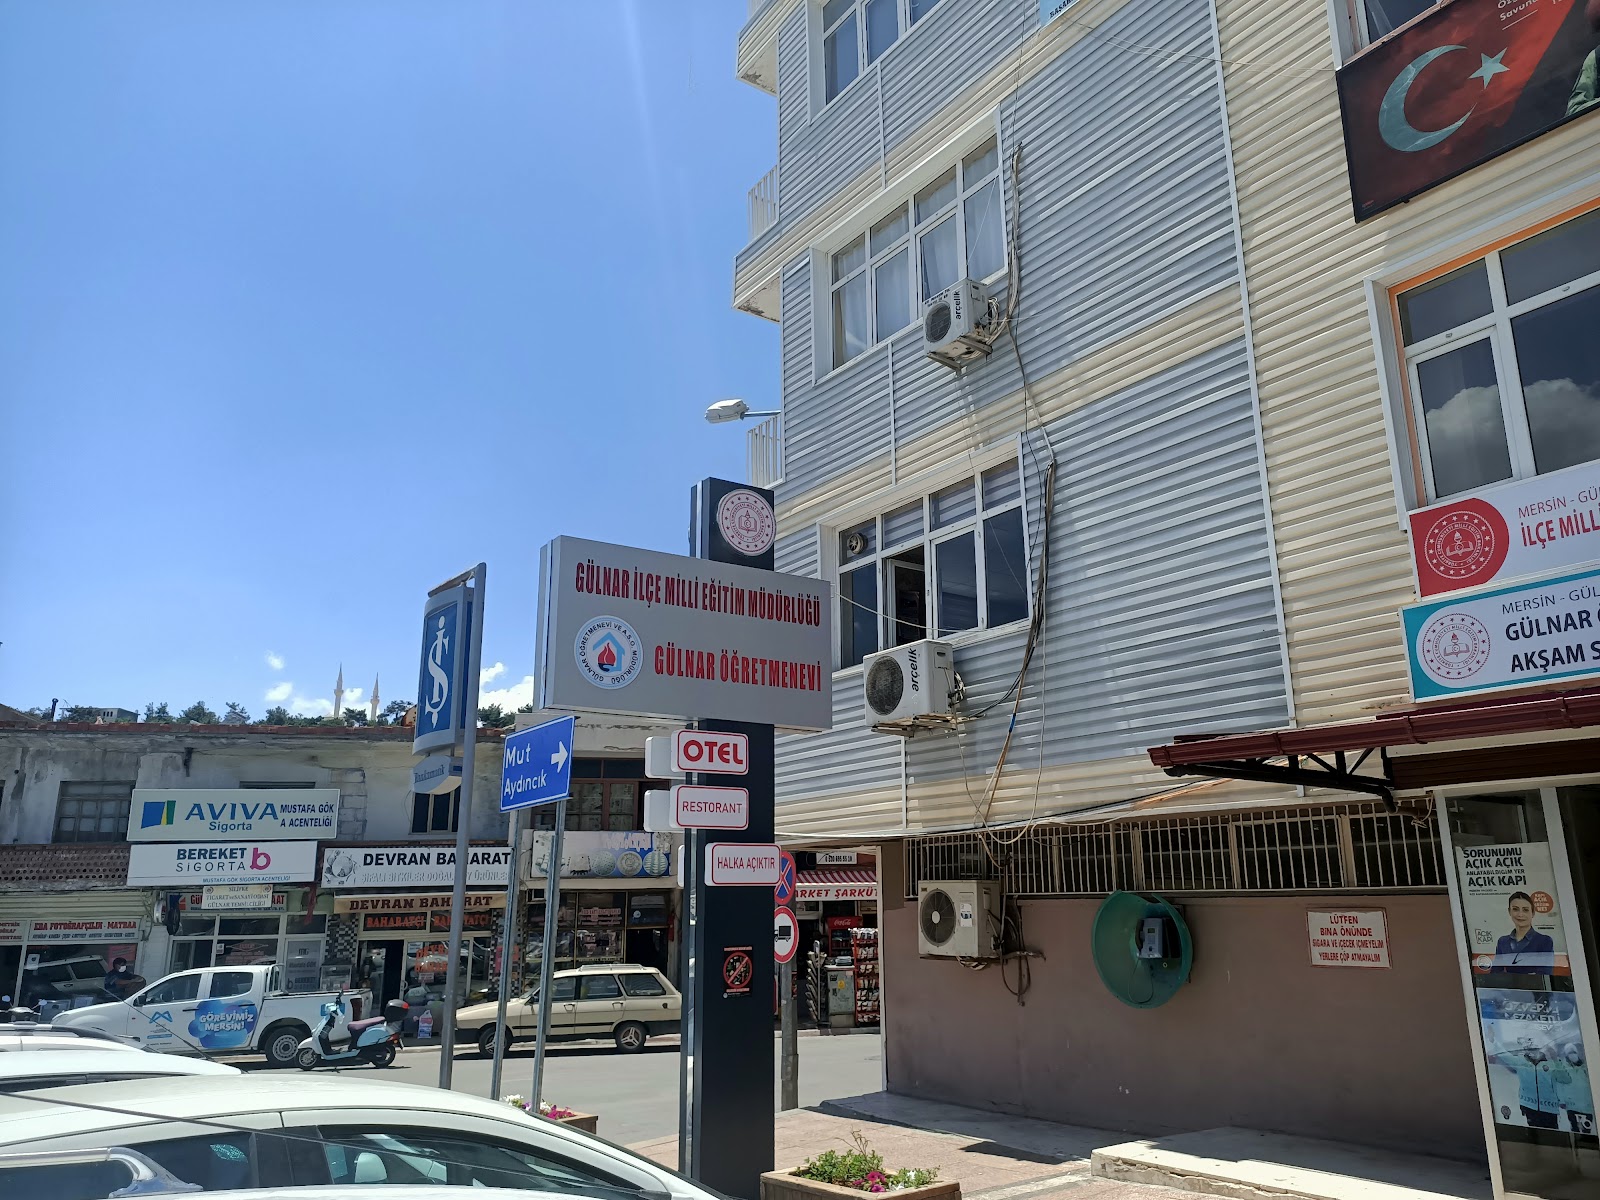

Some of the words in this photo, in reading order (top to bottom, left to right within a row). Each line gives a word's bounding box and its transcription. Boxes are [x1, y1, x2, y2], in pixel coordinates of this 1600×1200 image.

[953, 290, 962, 320] arçelik
[1518, 496, 1567, 518] MERSİN
[1521, 522, 1556, 549] İLÇE
[575, 559, 630, 599] GÜLNAR
[633, 566, 661, 609] İLÇE
[664, 573, 699, 609] MİLLİ
[701, 578, 745, 616] EĞİTİM
[748, 587, 821, 627] MÜDÜRLÜĞÜ
[1502, 594, 1556, 615] MERSİN
[613, 623, 623, 632] VE
[1505, 609, 1593, 641] GÜLNAR
[579, 621, 612, 657] ÖĞRETMENEVİ
[1511, 643, 1586, 673] AKŞAM
[581, 658, 604, 683] GÜLNAR
[611, 650, 639, 685] MÜDÜRLÜĞÜ
[654, 642, 715, 681] GÜLNAR
[719, 649, 822, 692] ÖĞRETMENEVİ
[908, 648, 920, 692] arçelik
[505, 743, 531, 769] Mut
[683, 739, 744, 765] OTEL
[504, 772, 547, 799] Aydıncık
[185, 802, 278, 820] AVIVA
[280, 804, 316, 814] MUSTAFA
[318, 802, 334, 814] GÖK
[682, 801, 743, 814] RESTORANT
[209, 821, 252, 832] Sigorta
[289, 816, 333, 828] ACENTELİĞİ
[176, 848, 247, 861] BEREKET
[363, 853, 430, 866] DEVRAN
[436, 852, 511, 865] BAARAT
[1463, 847, 1523, 859] SORUNUMU
[717, 856, 744, 870] HALKA
[747, 856, 775, 873] AÇIKTIR
[1465, 858, 1492, 870] AÇIK
[1495, 856, 1524, 869] AÇIK
[1468, 876, 1496, 888] AÇIK
[1498, 875, 1527, 886] KAPI
[350, 898, 414, 910] DEVRAN
[419, 896, 493, 908] BAHRAT
[366, 915, 424, 929] BAHARATÇI
[1329, 914, 1359, 924] LÜTFEN
[1320, 927, 1338, 936] BİNA
[1340, 925, 1373, 937] ÖNÜNDE
[1319, 952, 1339, 961] YERLERE
[1340, 950, 1350, 963] ÇÖP
[200, 1009, 254, 1022] GÖREVİMİZ
[204, 1021, 245, 1032] MERSİN!
